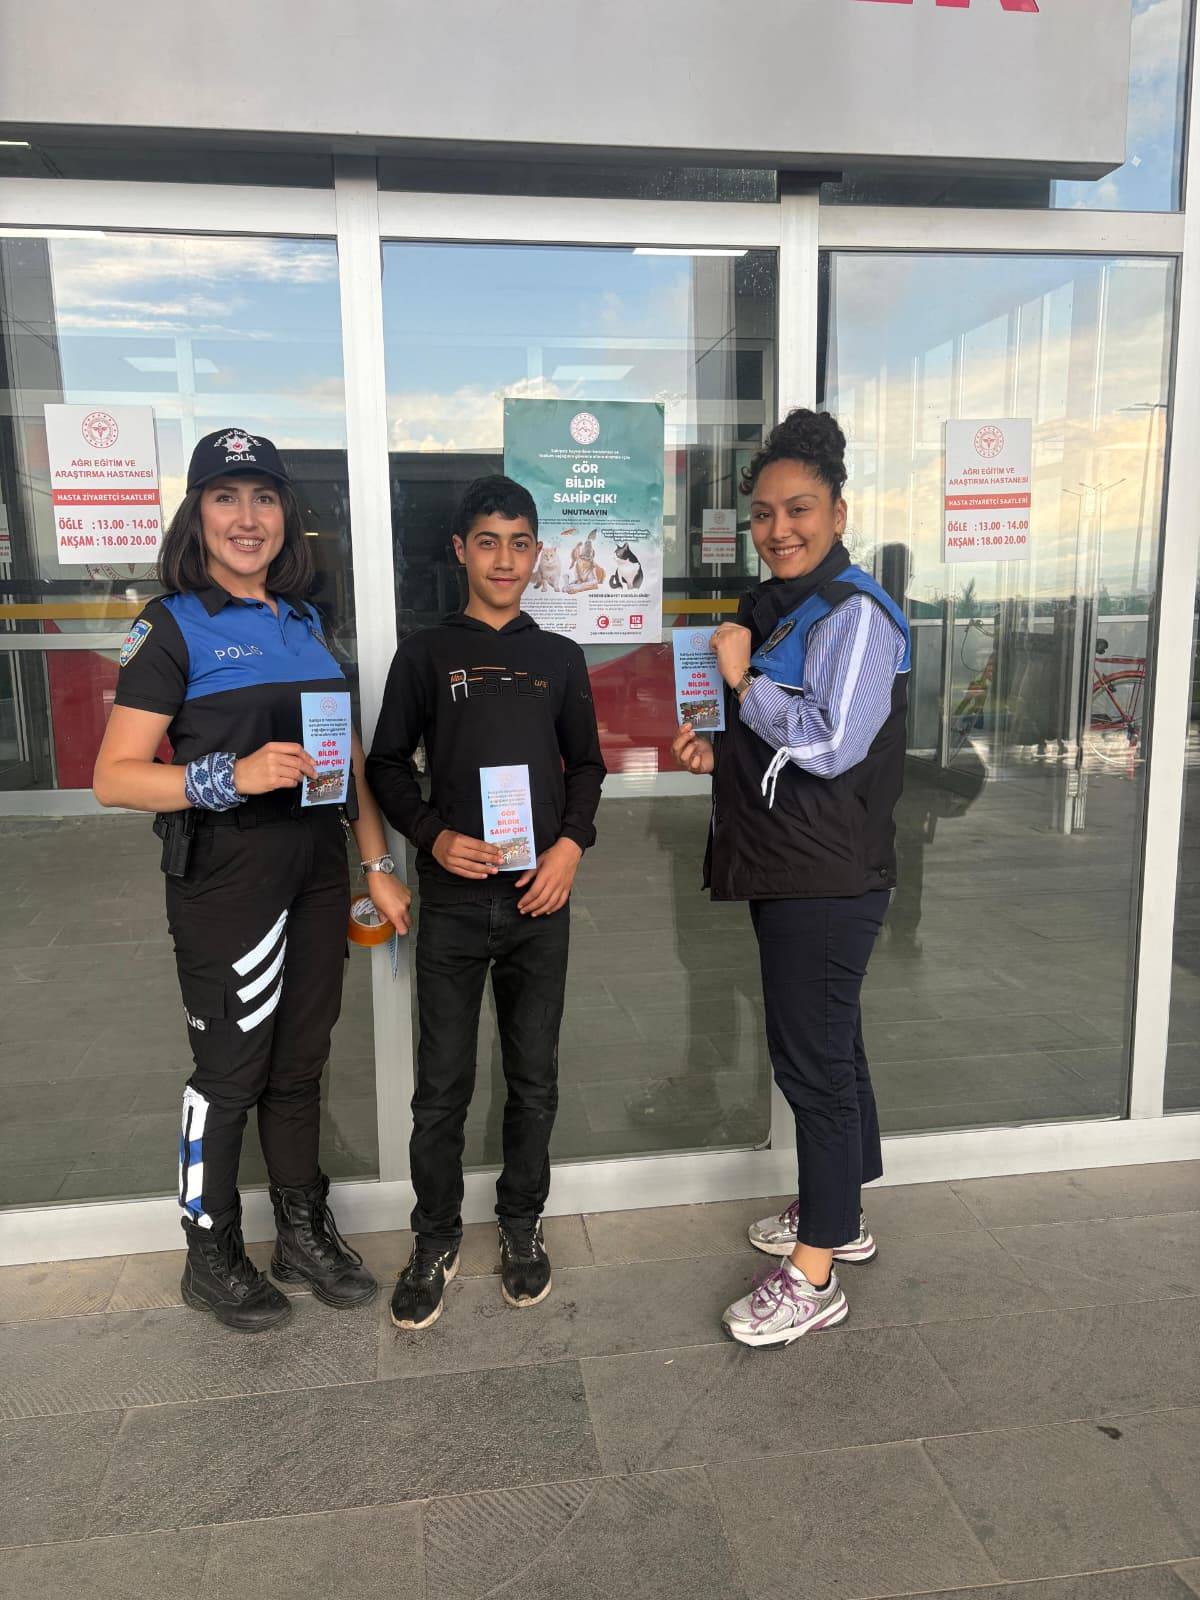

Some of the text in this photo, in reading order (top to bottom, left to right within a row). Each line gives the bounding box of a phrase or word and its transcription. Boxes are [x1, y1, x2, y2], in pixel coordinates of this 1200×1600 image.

[71, 458, 92, 467] AĞRI
[94, 458, 123, 467] EĞİTİM
[572, 460, 599, 474] GÖR
[55, 469, 154, 480] ARAŞTIRMA HASTANESİ
[962, 467, 980, 475] AĞRI
[981, 466, 1005, 475] EĞİTİM
[566, 476, 606, 489] BİLDİR
[949, 476, 1029, 487] ARAŞTIRMA HASTANESİ
[83, 493, 120, 502] ZİYARETÇİ
[553, 490, 617, 506] SAHİP ÇIK!
[58, 517, 84, 530] ÖĞLE
[132, 519, 159, 530] 14.00
[948, 520, 968, 532] ÖĞLE
[1007, 520, 1029, 530] 14.00
[60, 536, 94, 549] AKŞAM
[948, 536, 976, 549] AKŞAM
[692, 671, 706, 679] GÖR
[688, 680, 710, 688] BİLDİR
[322, 740, 337, 748] GÖR
[318, 749, 339, 757] BİLDİR
